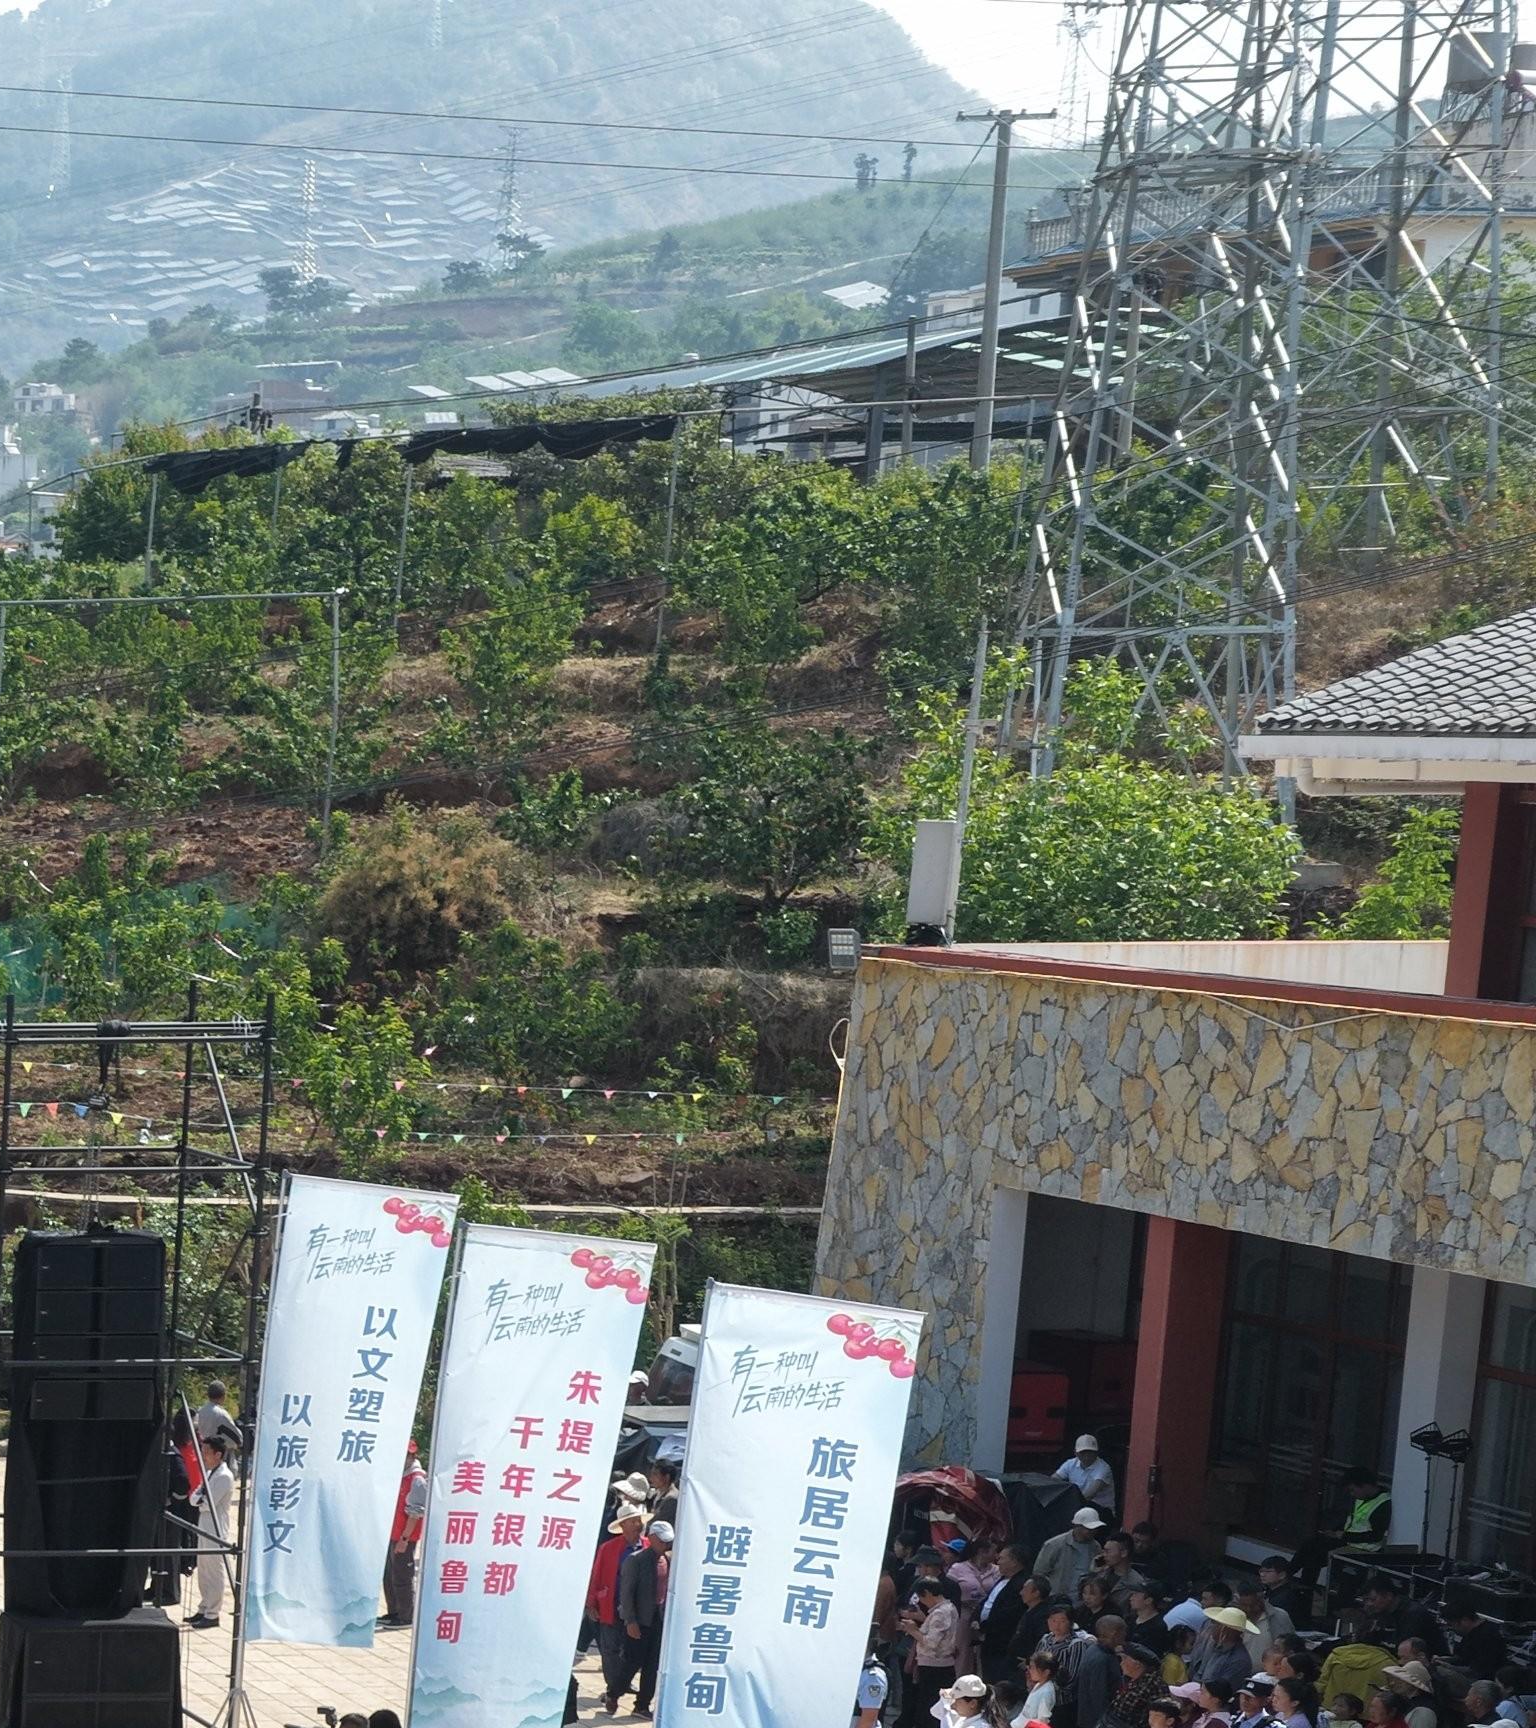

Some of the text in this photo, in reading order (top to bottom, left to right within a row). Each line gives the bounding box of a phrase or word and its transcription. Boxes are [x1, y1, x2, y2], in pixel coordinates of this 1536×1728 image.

[306, 1223, 376, 1257] 有一种叫
[306, 1250, 396, 1284] 云南的生活
[484, 1277, 564, 1322] 有一种叫
[336, 1305, 398, 1465] 以文塑旅
[485, 1305, 585, 1344] 云南的生活
[730, 1344, 818, 1391] 有一种叫
[732, 1379, 846, 1418] 云南的生活
[262, 1392, 313, 1556] 以旅彰文
[483, 1416, 544, 1597] 千年银都
[538, 1370, 603, 1551] 朱提之源
[782, 1435, 856, 1631] 旅居云南
[435, 1460, 486, 1645] 美丽鲁甸
[683, 1523, 752, 1717] 避暑鲁甸
